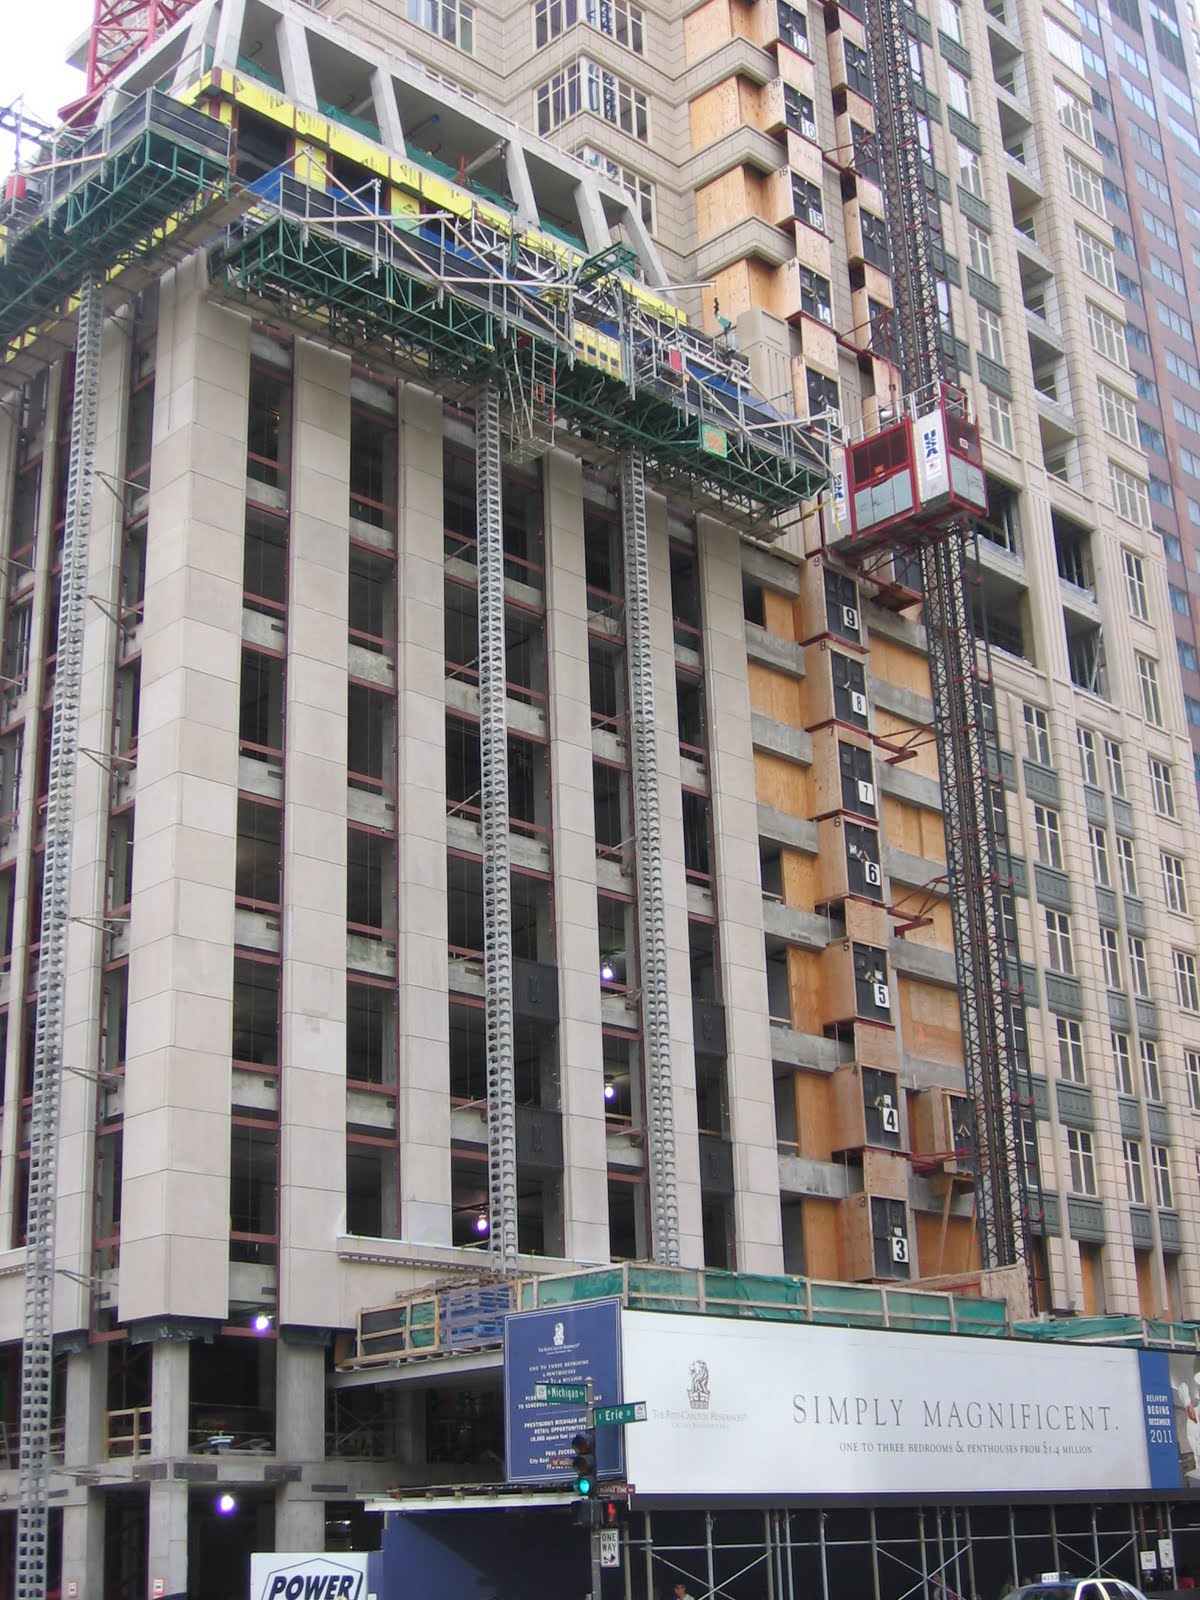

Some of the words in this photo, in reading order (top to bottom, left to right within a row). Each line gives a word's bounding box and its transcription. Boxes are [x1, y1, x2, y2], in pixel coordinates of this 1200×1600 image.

[802, 121, 816, 140] 16
[811, 210, 822, 228] 15
[818, 304, 830, 324] 14
[846, 608, 856, 628] 9
[820, 640, 826, 650] 8
[856, 696, 862, 712] 8
[864, 784, 869, 801] 7
[834, 816, 841, 828] 6
[868, 864, 878, 882] 6
[843, 942, 850, 952] 5
[878, 987, 886, 1005] 5
[886, 1110, 896, 1130] 4
[896, 1240, 905, 1260] 3
[552, 1387, 578, 1401] Michigan
[606, 1409, 623, 1421] Erie
[793, 1394, 904, 1426] SIMPLY
[922, 1400, 1119, 1431] MAGNIFICENT.
[1147, 1405, 1170, 1415] BEGINS
[1150, 1429, 1173, 1443] 2011
[840, 1442, 858, 1452] ONE
[862, 1443, 874, 1452] TO
[877, 1443, 904, 1453] THREE
[908, 1444, 953, 1453] BEDROOMS
[956, 1441, 964, 1453] &
[968, 1444, 1018, 1454] PENTHOUSES
[1020, 1445, 1041, 1454] FROM
[1042, 1441, 1060, 1456] $1.4
[1062, 1445, 1093, 1454] MILLION
[602, 1533, 616, 1541] ONE
[602, 1543, 616, 1552] WAY
[268, 1575, 354, 1600] POWER
